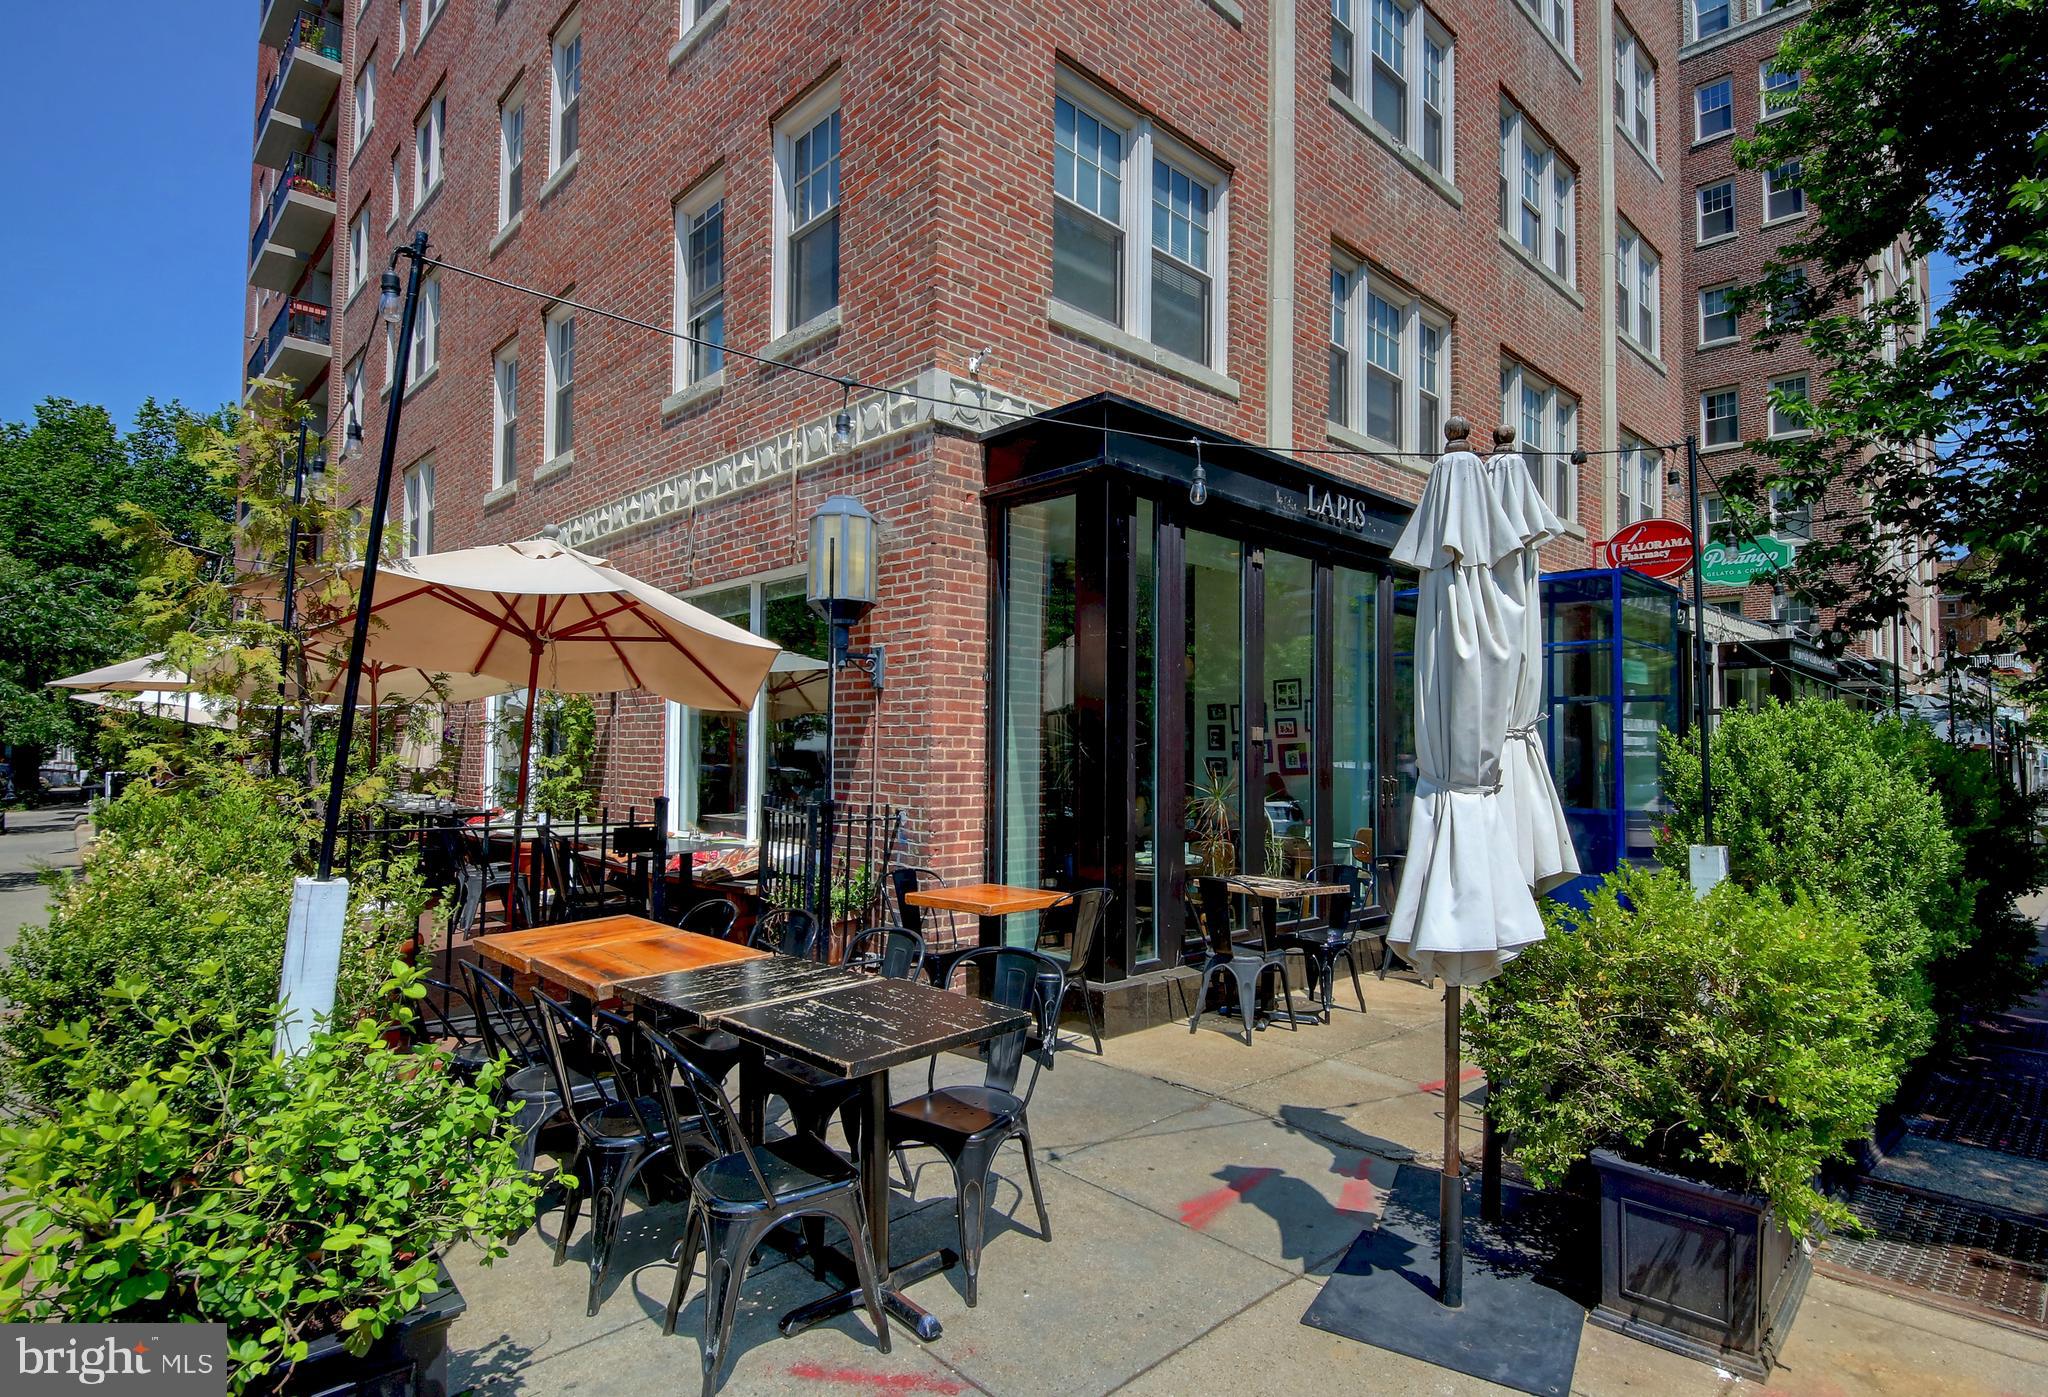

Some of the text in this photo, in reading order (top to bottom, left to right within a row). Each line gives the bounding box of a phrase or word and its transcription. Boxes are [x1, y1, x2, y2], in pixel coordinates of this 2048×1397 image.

[1307, 484, 1366, 527] LAPIS
[1621, 537, 1692, 553] KALORAMA
[1621, 550, 1671, 562] Pharmacy
